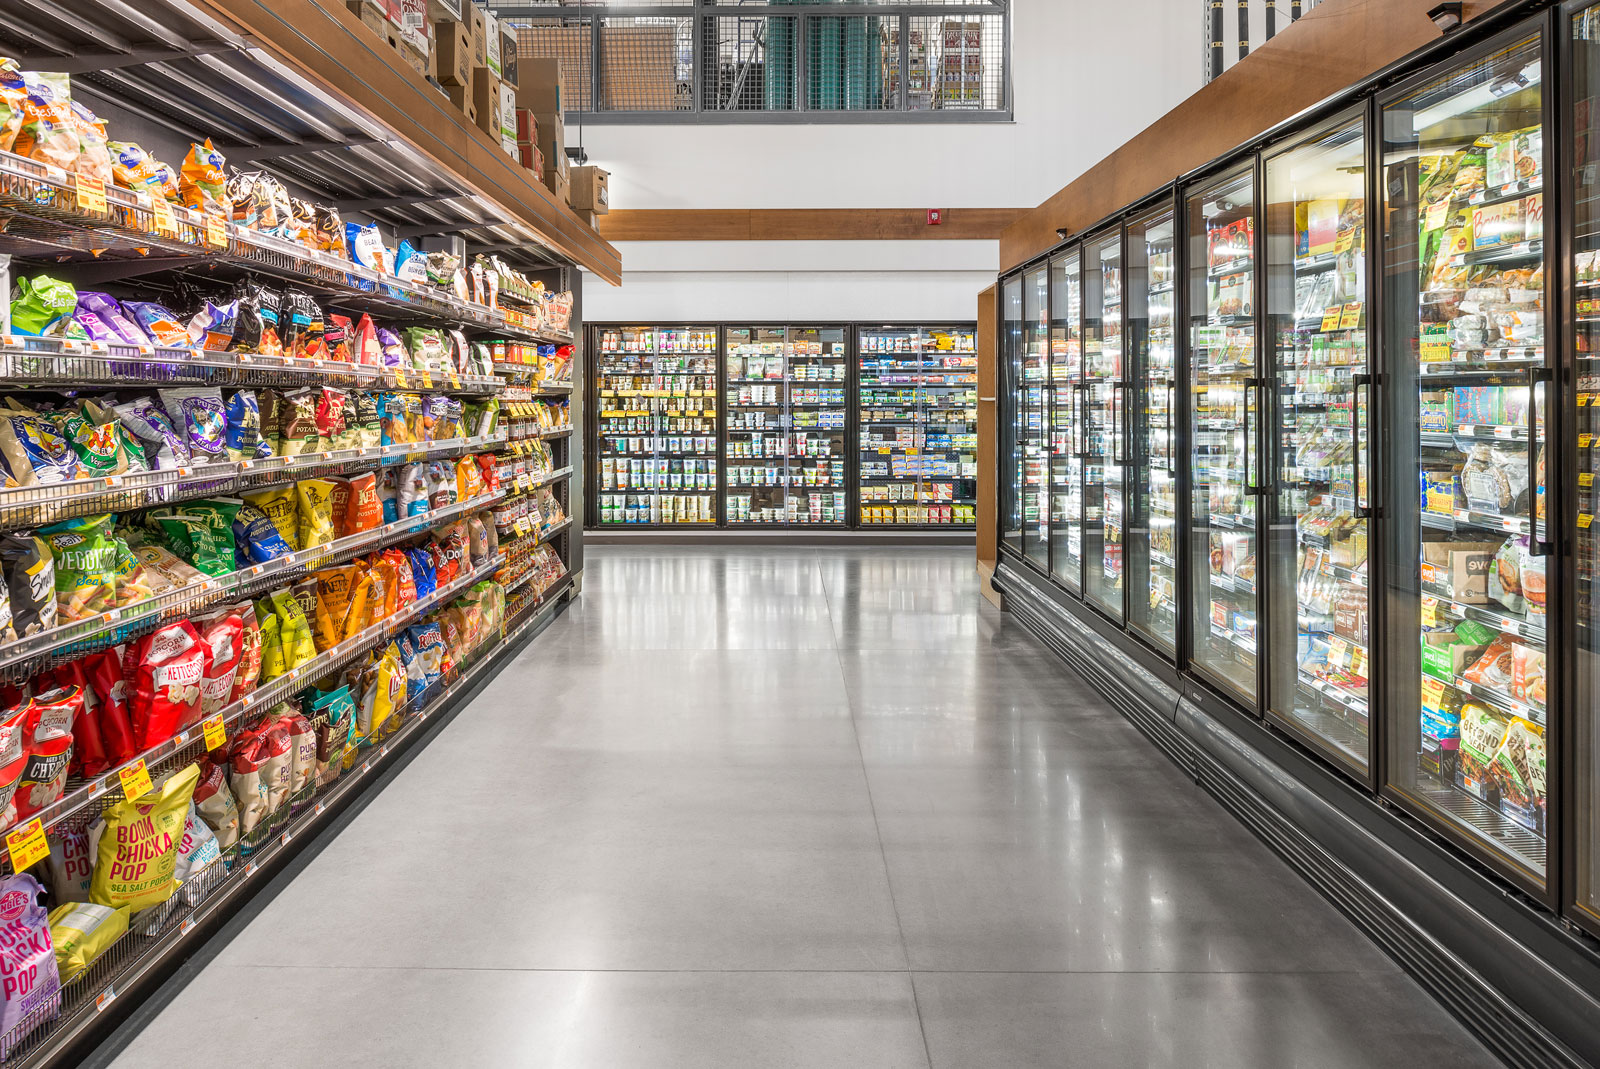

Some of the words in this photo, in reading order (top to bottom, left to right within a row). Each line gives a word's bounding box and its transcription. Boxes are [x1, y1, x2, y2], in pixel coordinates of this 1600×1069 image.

[75, 575, 99, 588] Sea
[1463, 720, 1499, 749] BEYOND
[117, 816, 155, 843] BOOM
[116, 832, 172, 863] CHICKA
[109, 861, 148, 881] POP
[111, 884, 127, 893] SEA
[130, 881, 149, 893] SALT
[150, 870, 174, 888] POPCO
[3, 964, 37, 1001] POP
